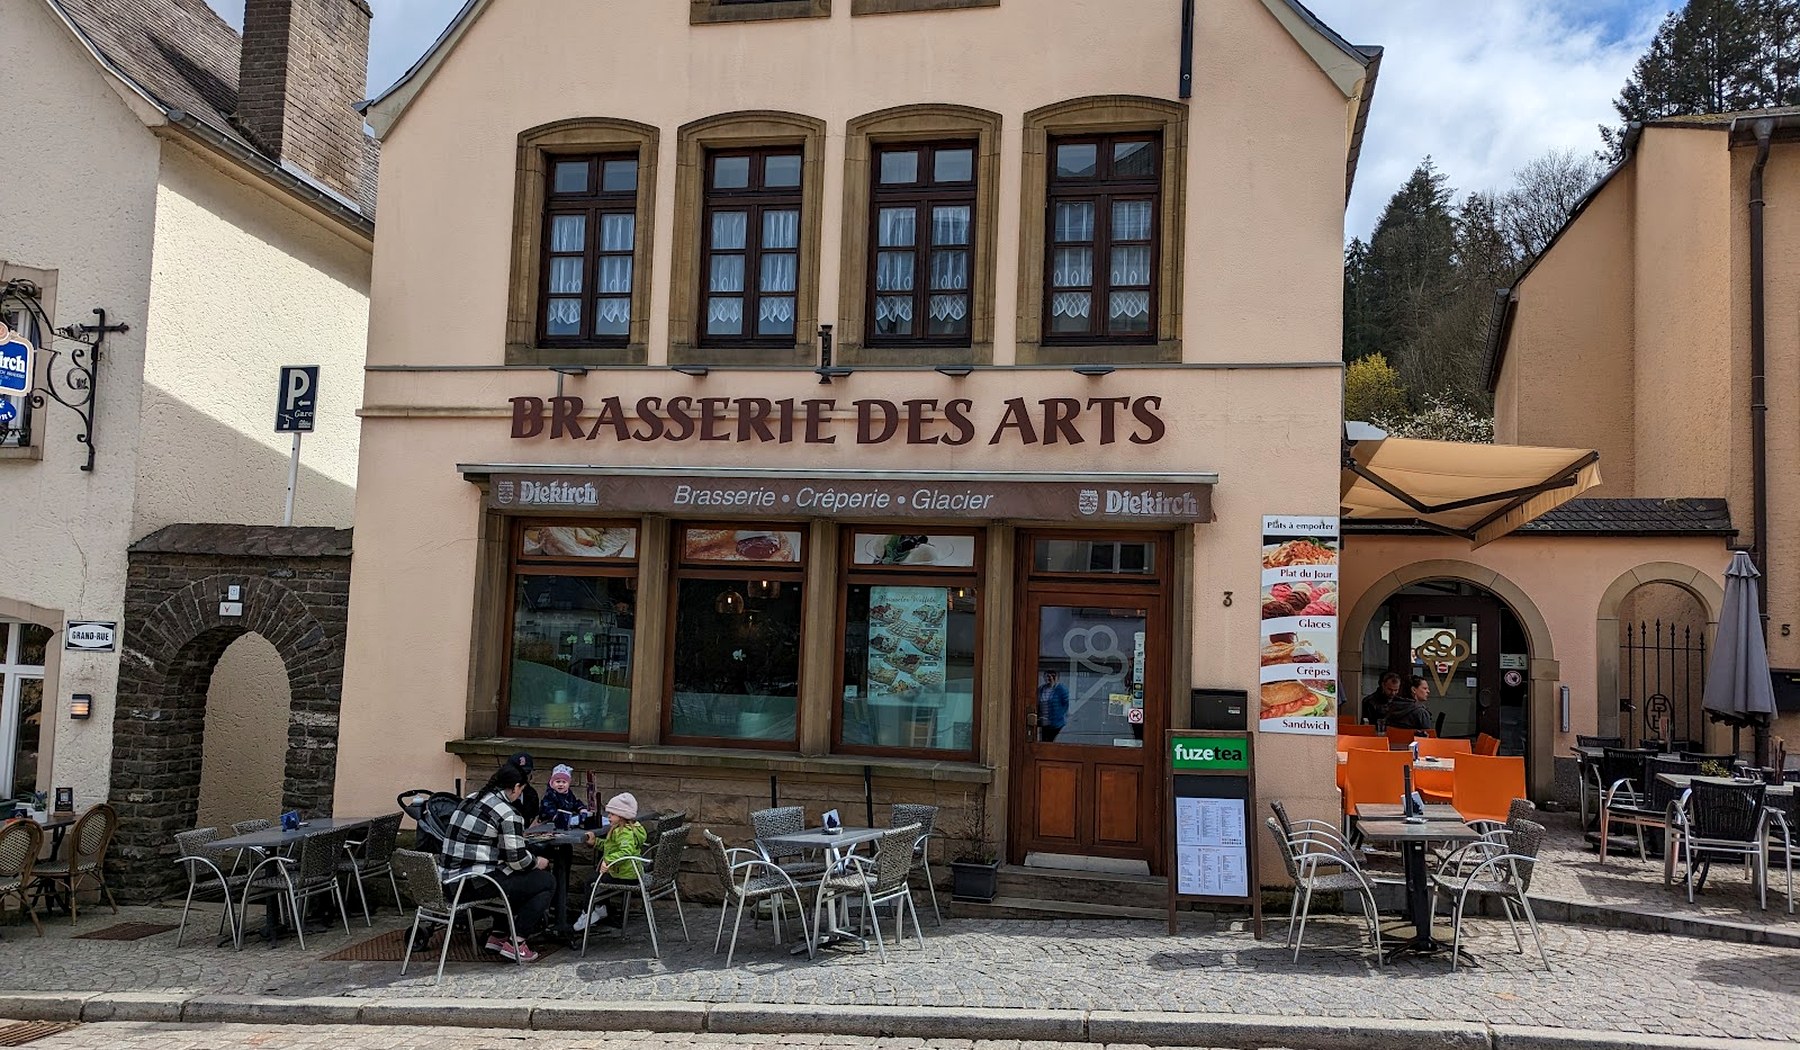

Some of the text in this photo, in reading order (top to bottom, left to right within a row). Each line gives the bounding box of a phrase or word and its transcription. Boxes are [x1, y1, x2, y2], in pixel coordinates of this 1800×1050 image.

[286, 369, 310, 410] P
[294, 410, 313, 418] Gare
[508, 396, 1166, 446] BRASSERIE DES ARTS
[520, 480, 597, 504] Diekirch
[674, 485, 994, 513] Brasserie Crêperie Glacier
[1105, 489, 1198, 516] Diekirch
[1296, 520, 1334, 531] emporter
[1280, 569, 1333, 579] Plat du Jour
[1223, 591, 1233, 607] 3
[1298, 619, 1332, 629] Glaces
[71, 631, 110, 641] GRAND-RUE
[1781, 624, 1791, 637] 5
[1296, 666, 1331, 678] Crêpes
[1282, 720, 1330, 731] Sandwich
